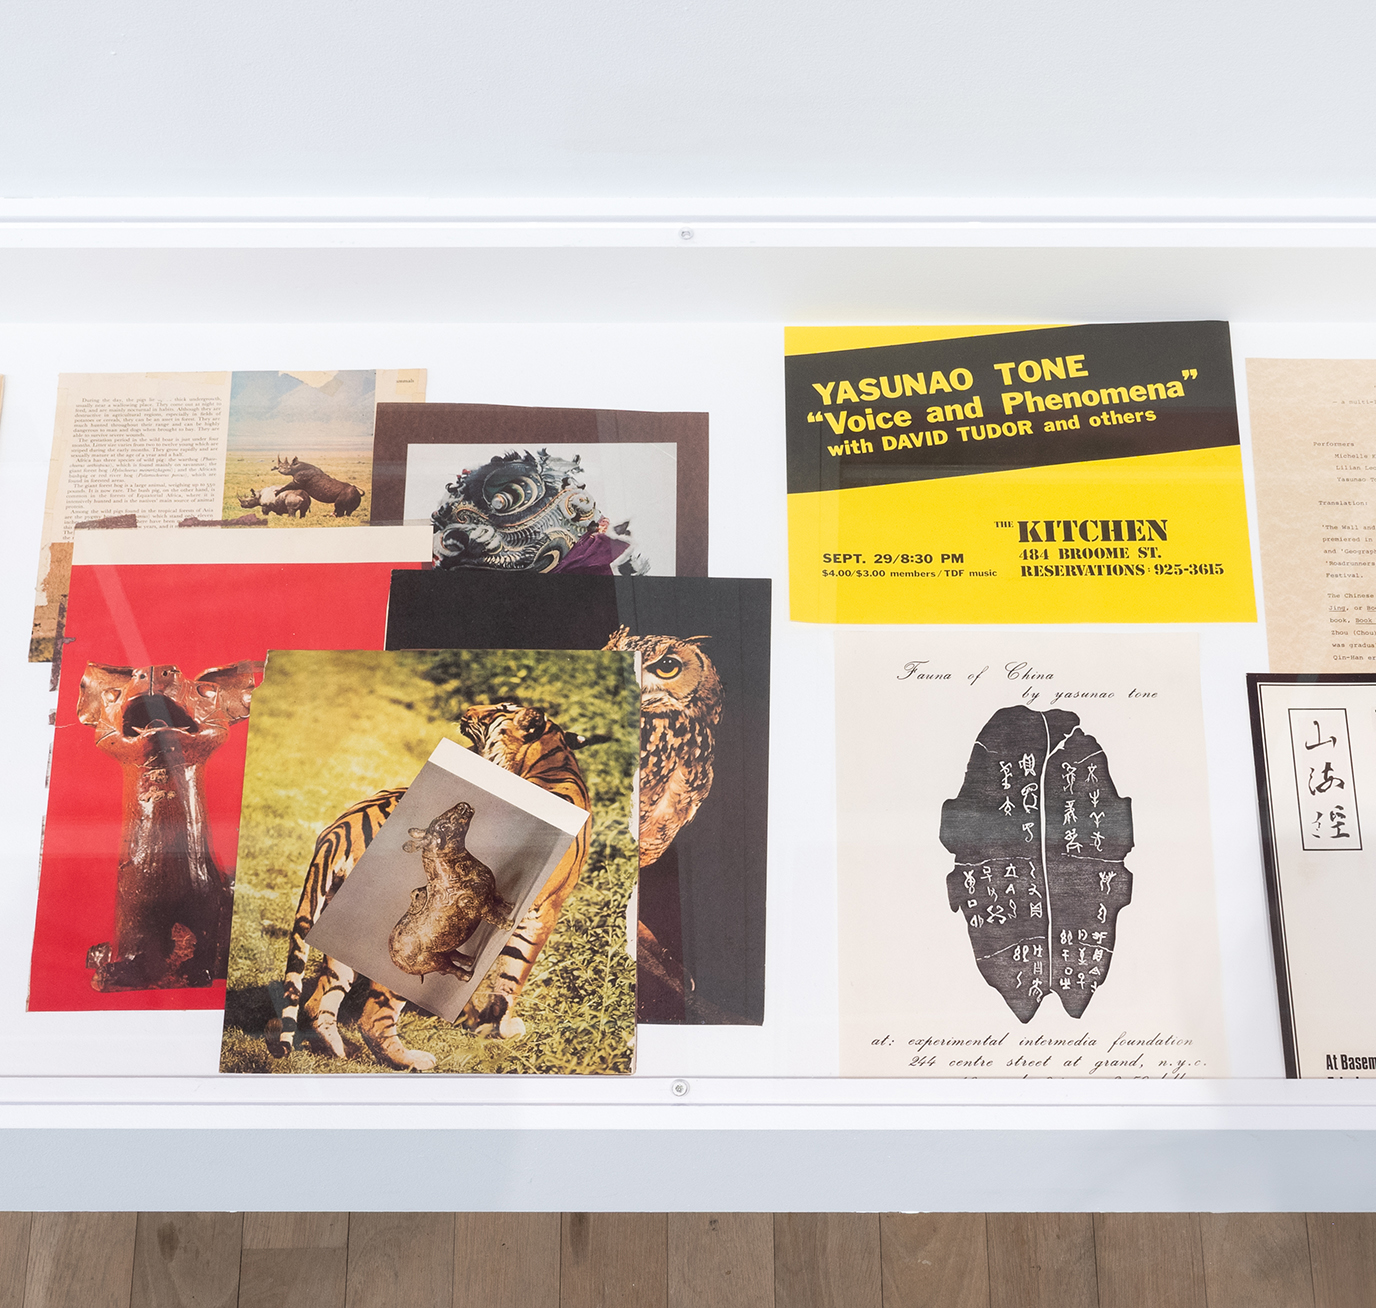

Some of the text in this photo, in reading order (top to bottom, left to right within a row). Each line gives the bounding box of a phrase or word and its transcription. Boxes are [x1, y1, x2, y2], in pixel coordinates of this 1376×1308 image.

[812, 354, 1089, 406] YASUNAO TONE
[926, 396, 984, 423] and
[827, 408, 1157, 457] with DAVID TUDOR and others
[1017, 519, 1169, 543] KITCHEN
[822, 553, 965, 565] SEPT. 29/8:30 PM
[1018, 546, 1162, 561] 484 BROOME ST.
[822, 569, 886, 578] $4.00/$3.00
[968, 569, 998, 577] music
[1154, 563, 1225, 576] 925-3615
[896, 660, 1054, 686] Fauna of China
[1022, 686, 1158, 705] by yasunao tone
[871, 1031, 1194, 1052] at: experimental intermedia foundation
[908, 1053, 1207, 1075] 244 centre street at grand, n.y.c.
[1326, 1054, 1338, 1070] At
